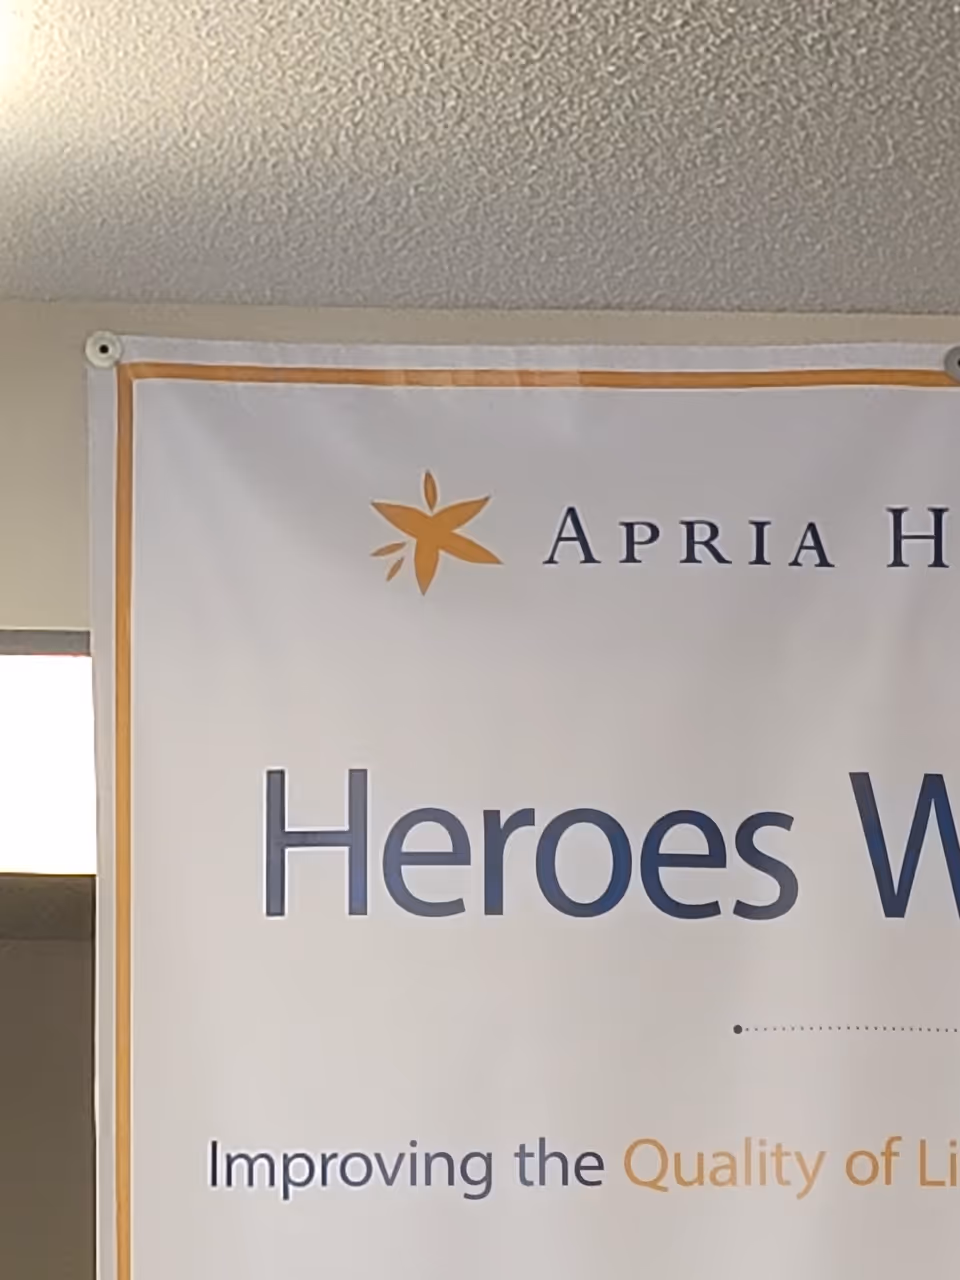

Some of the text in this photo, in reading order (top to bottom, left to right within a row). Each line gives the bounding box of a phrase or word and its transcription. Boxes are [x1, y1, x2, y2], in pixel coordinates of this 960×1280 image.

[543, 506, 835, 568] APRIA
[266, 768, 798, 921] Heroes
[210, 1139, 493, 1201] Improving
[513, 1136, 605, 1187] the
[623, 1137, 826, 1199] Quality
[845, 1135, 903, 1187] of
